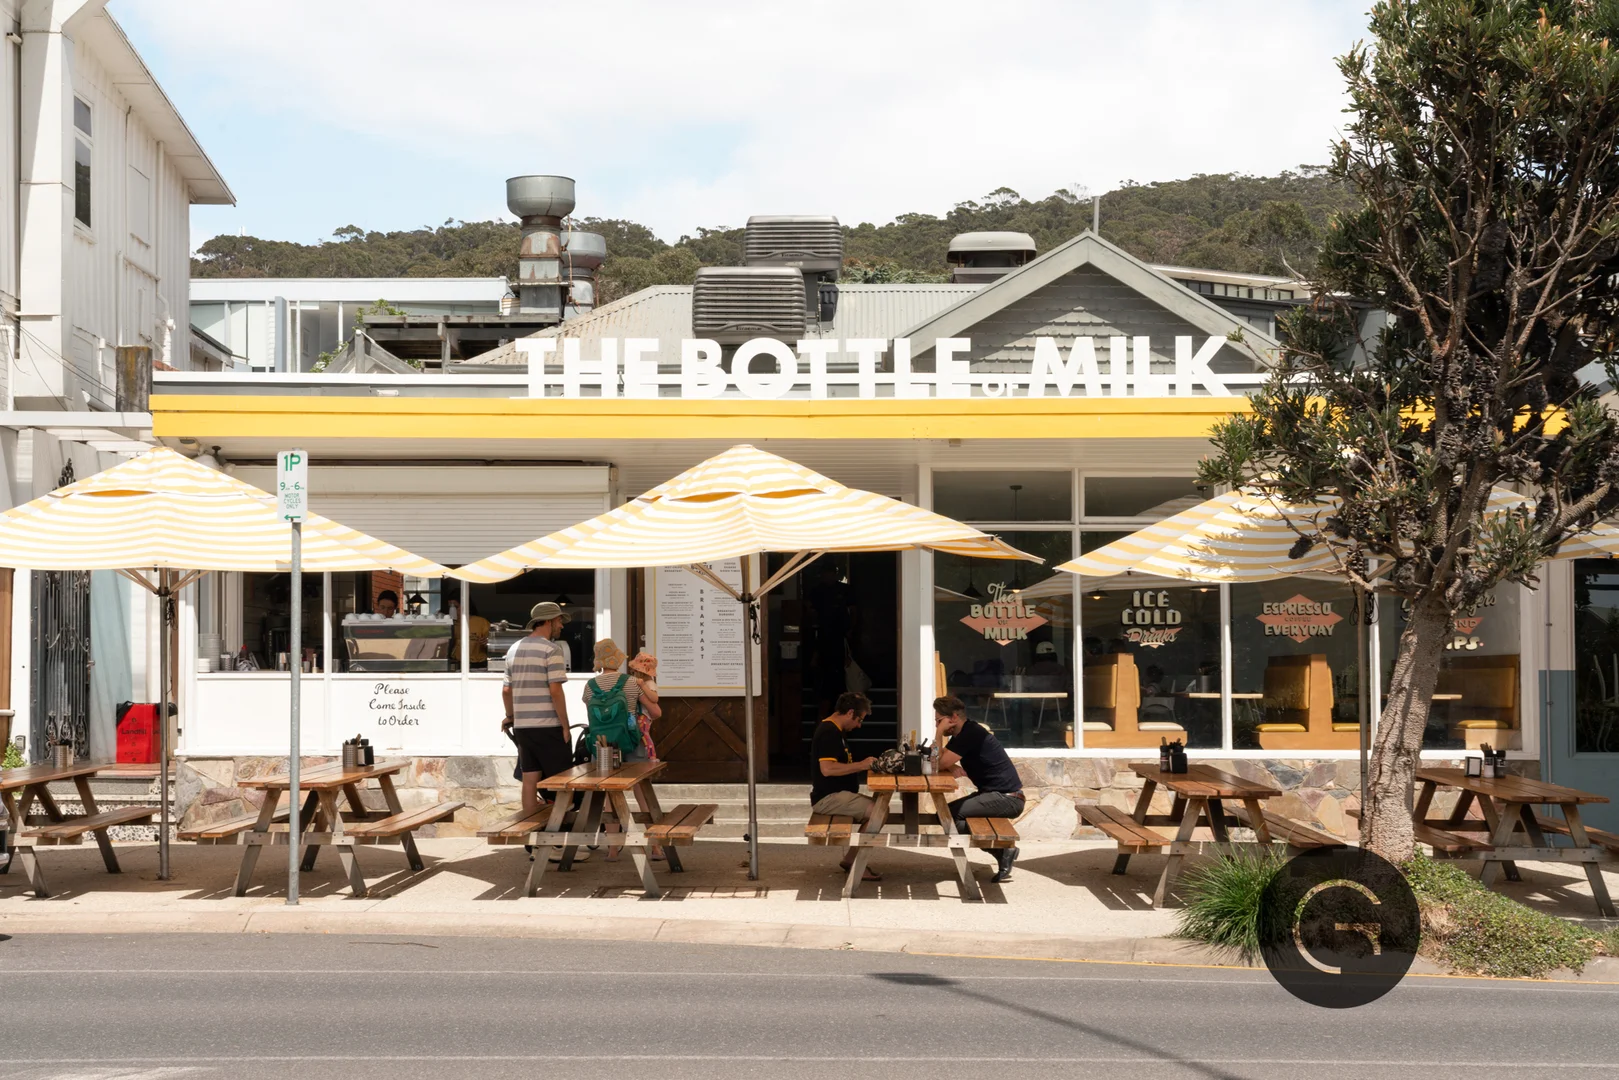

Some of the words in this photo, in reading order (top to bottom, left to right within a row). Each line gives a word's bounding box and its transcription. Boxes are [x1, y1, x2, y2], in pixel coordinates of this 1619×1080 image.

[515, 338, 660, 398] THE
[681, 337, 971, 398] BOTTLE
[981, 377, 1020, 398] OF
[1027, 335, 1232, 398] MILK
[283, 454, 301, 472] 1P
[987, 581, 1015, 604] The
[1132, 590, 1170, 608] ICE
[969, 604, 1037, 619] BOTTLE
[1262, 601, 1332, 616] ESPRESSO
[1121, 608, 1182, 626] COLD
[1457, 620, 1477, 628] ND
[984, 626, 1028, 641] MILK
[1126, 627, 1178, 643] Drinks
[1264, 624, 1335, 637] EVERYDAY
[373, 682, 410, 695] Please
[368, 698, 396, 710] Come
[397, 698, 427, 710] Inside
[378, 716, 388, 726] to
[388, 714, 420, 726] Order
[121, 728, 147, 736] Landfill
